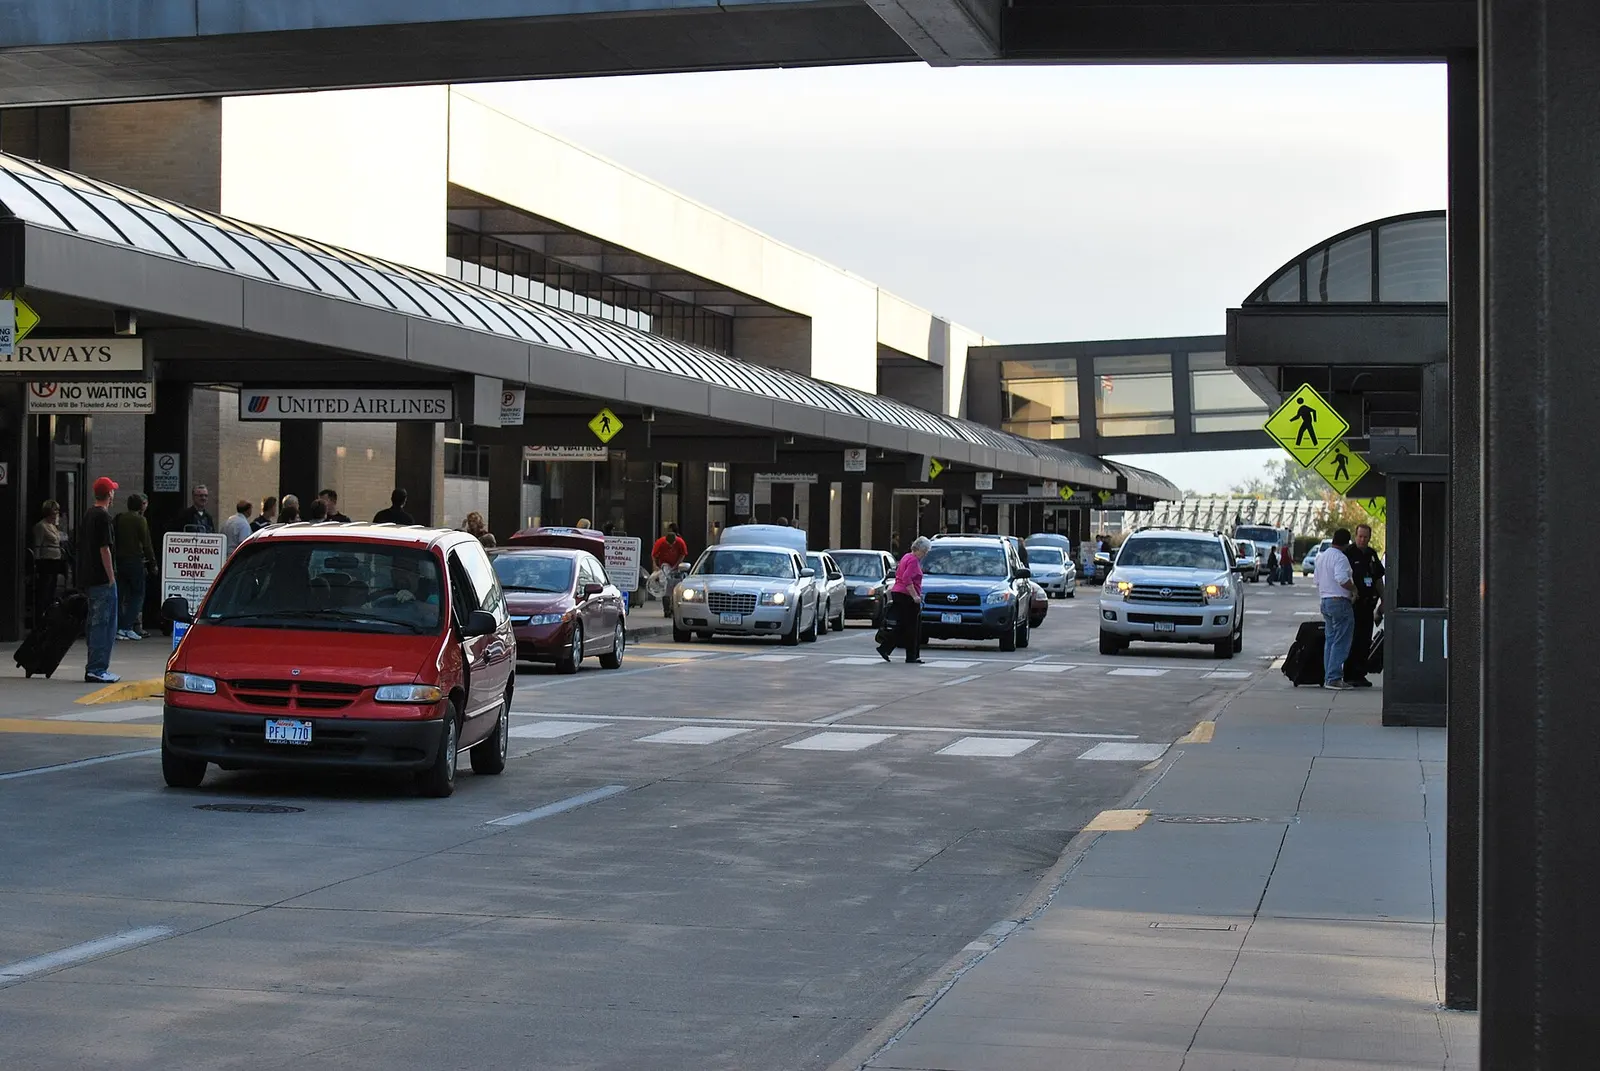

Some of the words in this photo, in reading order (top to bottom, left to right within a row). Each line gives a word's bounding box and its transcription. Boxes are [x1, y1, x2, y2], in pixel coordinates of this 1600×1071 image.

[0, 346, 112, 362] RWAYS
[60, 386, 82, 399] NO
[86, 386, 147, 399] WAITING
[277, 395, 349, 414] UNITED
[352, 396, 446, 414] AIRLINES
[168, 546, 180, 554] NO
[183, 547, 220, 555] PARKING
[172, 562, 214, 570] TERMINAL
[180, 570, 206, 578] DRIVE
[269, 726, 286, 739] PFJ
[292, 727, 309, 740] 770
